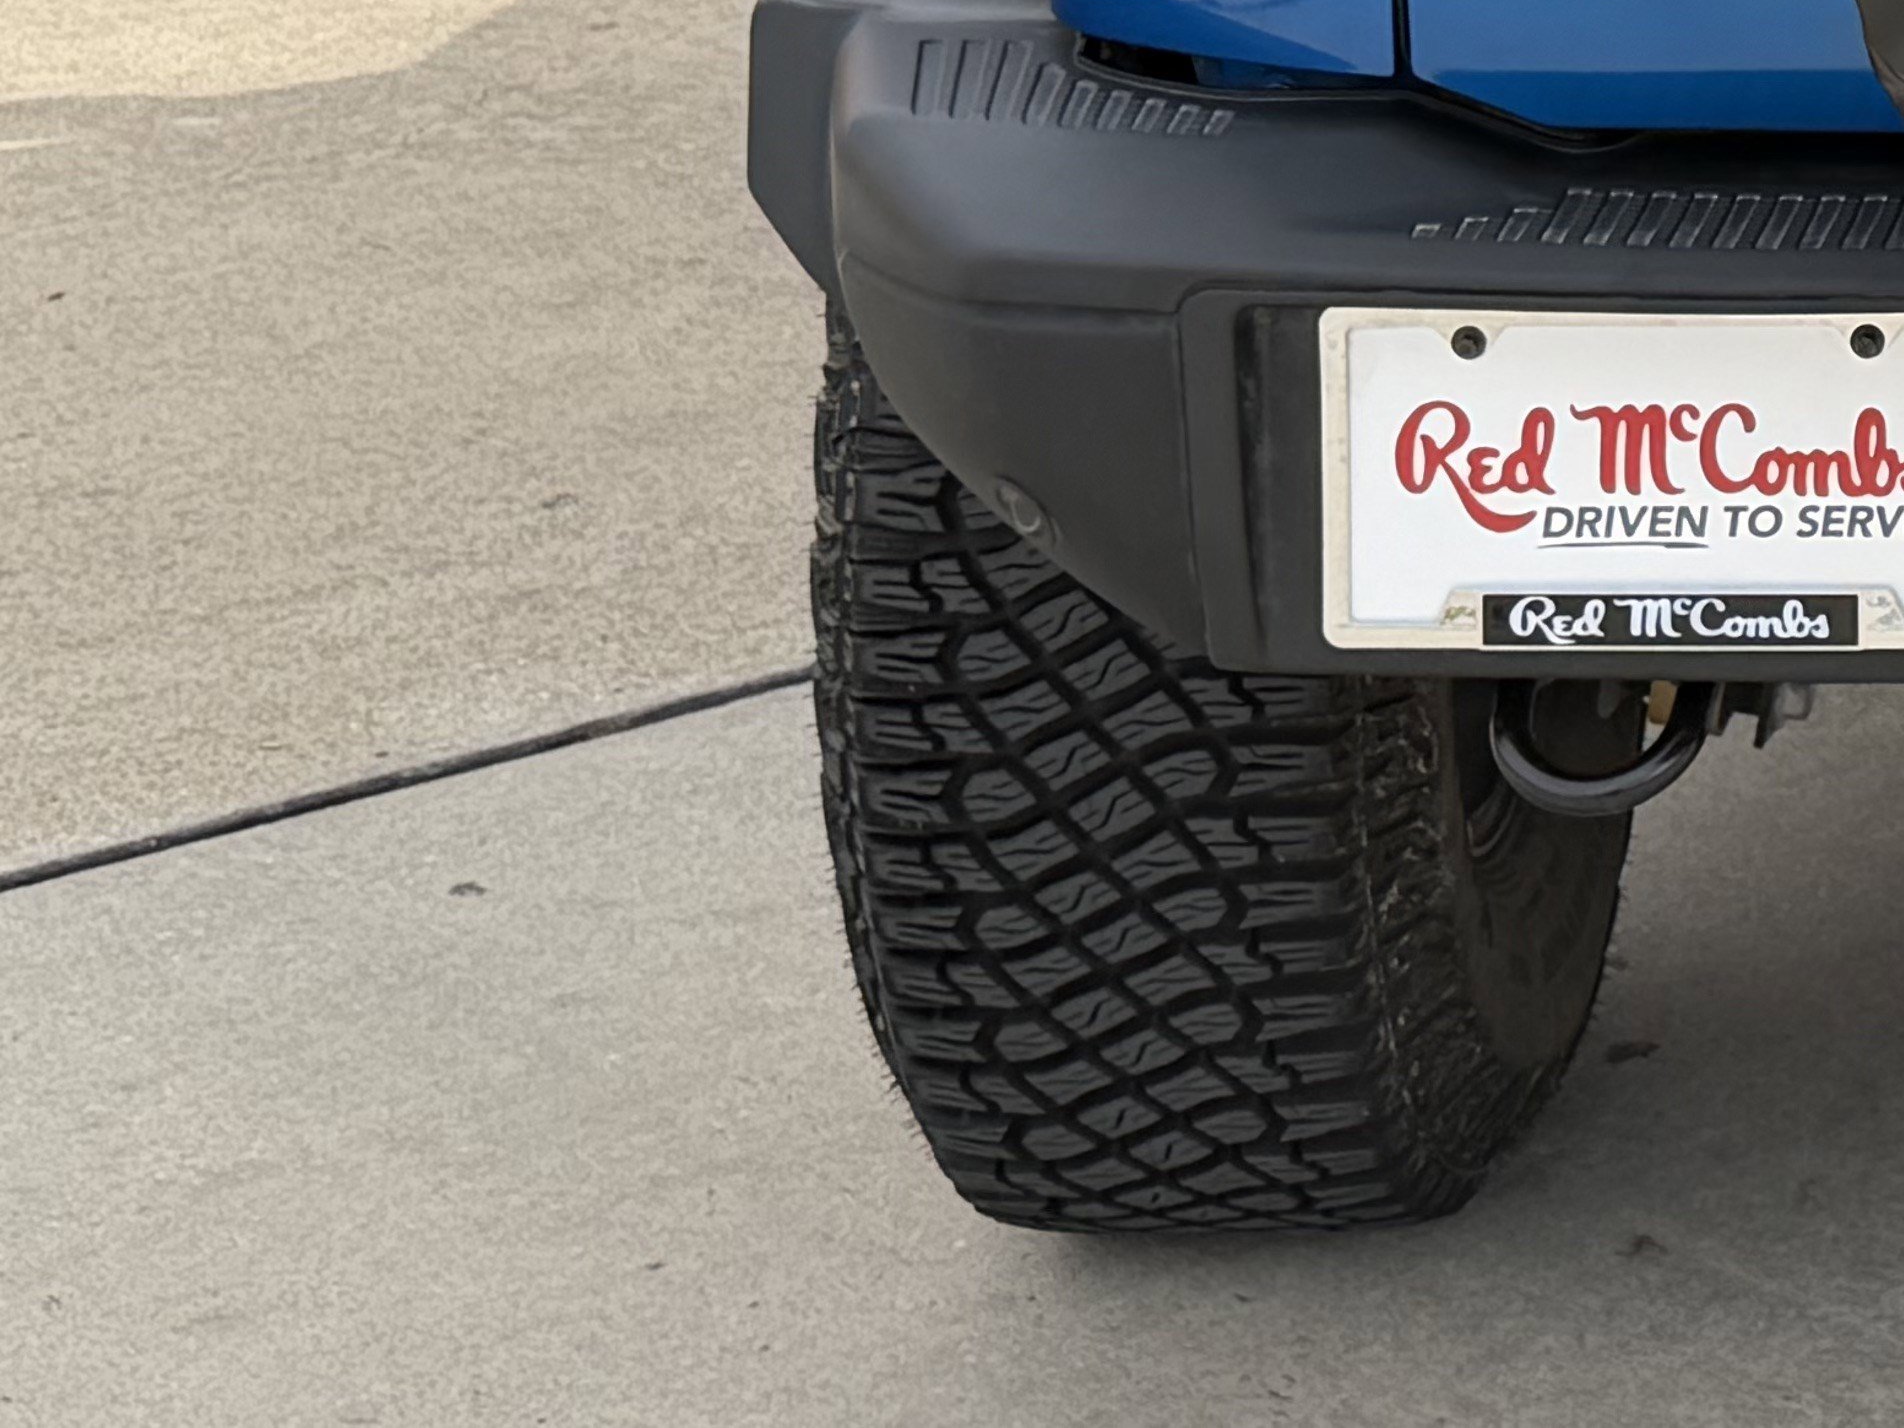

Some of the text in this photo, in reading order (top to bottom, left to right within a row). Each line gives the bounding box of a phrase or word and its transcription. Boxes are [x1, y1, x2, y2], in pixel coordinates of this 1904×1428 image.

[1395, 401, 1555, 533] Red
[1542, 505, 1709, 538] DRIVEN
[1723, 505, 1783, 538] TO
[1508, 596, 1830, 644] Red McCombs
